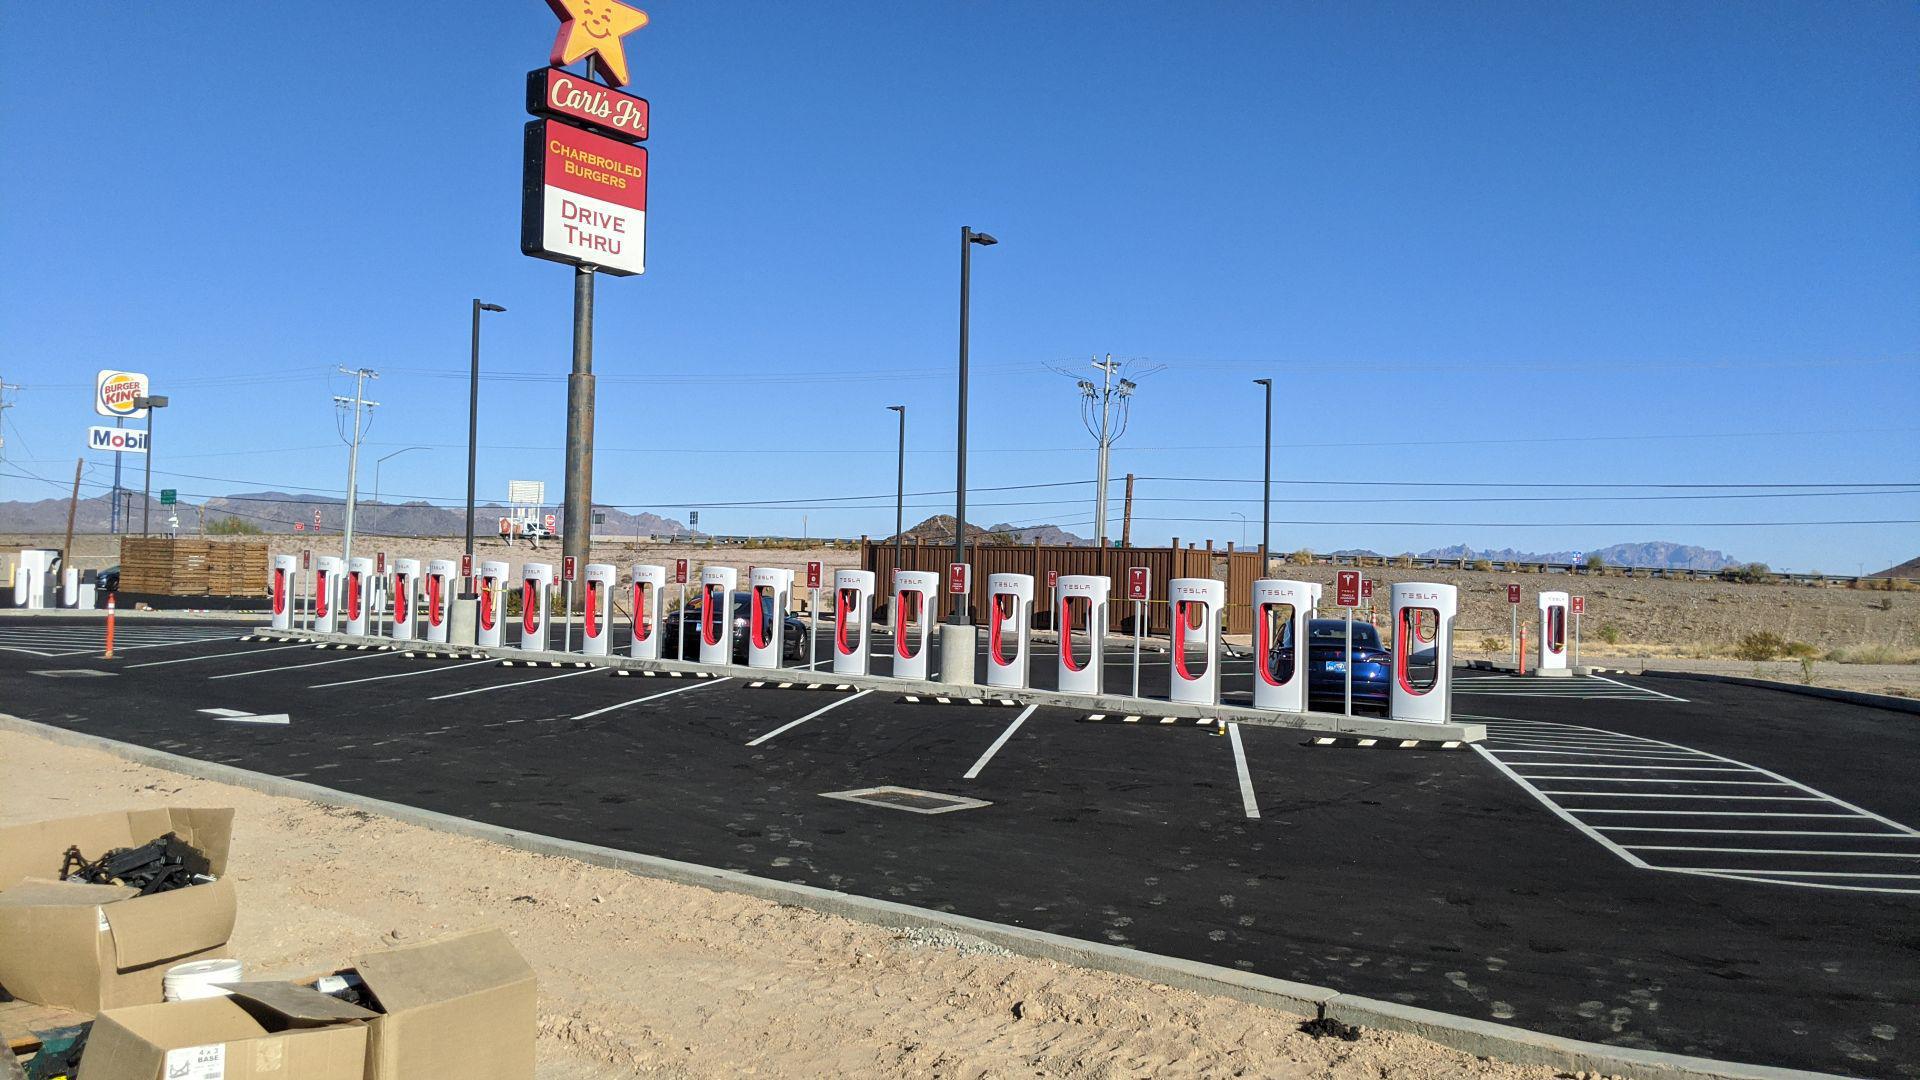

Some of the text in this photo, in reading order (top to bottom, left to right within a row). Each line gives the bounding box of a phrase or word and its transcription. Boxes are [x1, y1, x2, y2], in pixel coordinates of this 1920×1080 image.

[551, 78, 646, 131] Carl's Jr.
[550, 140, 642, 178] CHARBROILED
[564, 160, 626, 189] BURGERS
[561, 199, 625, 234] DRIVE
[564, 224, 621, 255] THRU
[104, 381, 141, 394] BURGER
[93, 429, 149, 449] Mobil
[1401, 592, 1438, 600] TESLA
[197, 1055, 220, 1063] BASE
